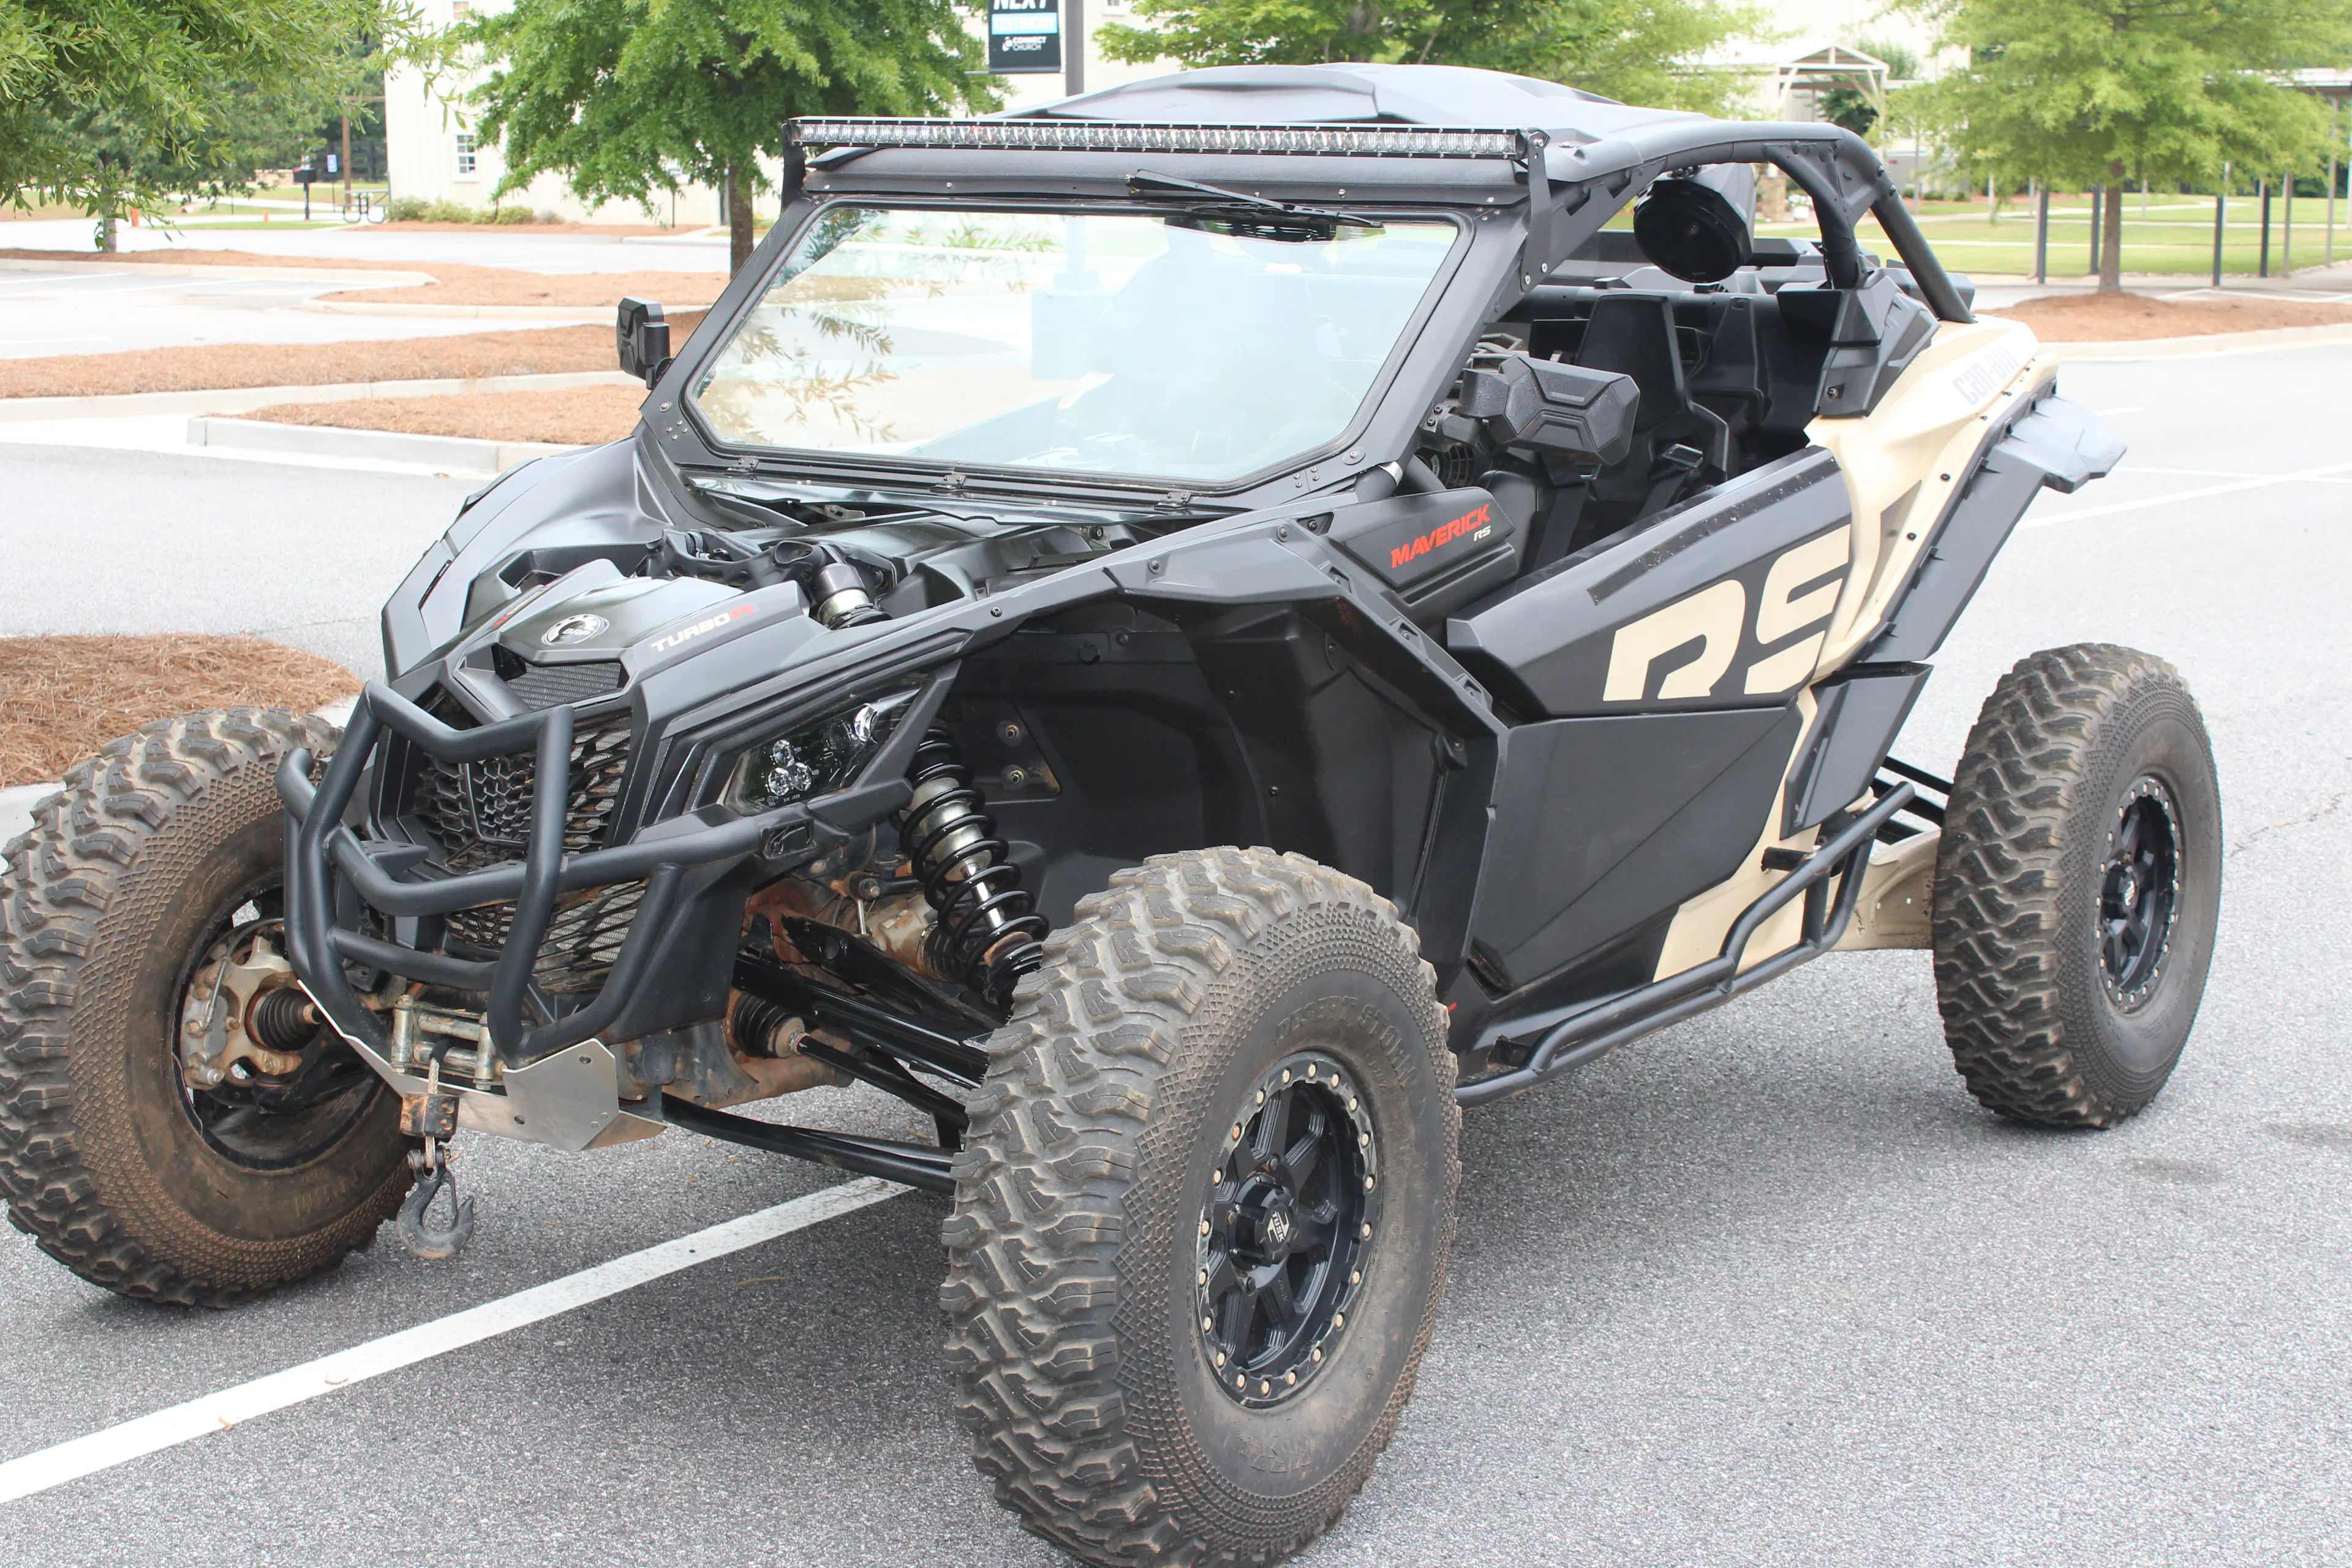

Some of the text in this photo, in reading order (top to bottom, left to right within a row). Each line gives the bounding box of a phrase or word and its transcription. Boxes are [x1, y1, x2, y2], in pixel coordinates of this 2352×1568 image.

[1390, 503, 1491, 568] MAVERICK
[1474, 525, 1491, 541] RS
[1602, 524, 1850, 701] RS
[1272, 1210, 1285, 1243] TUSK
